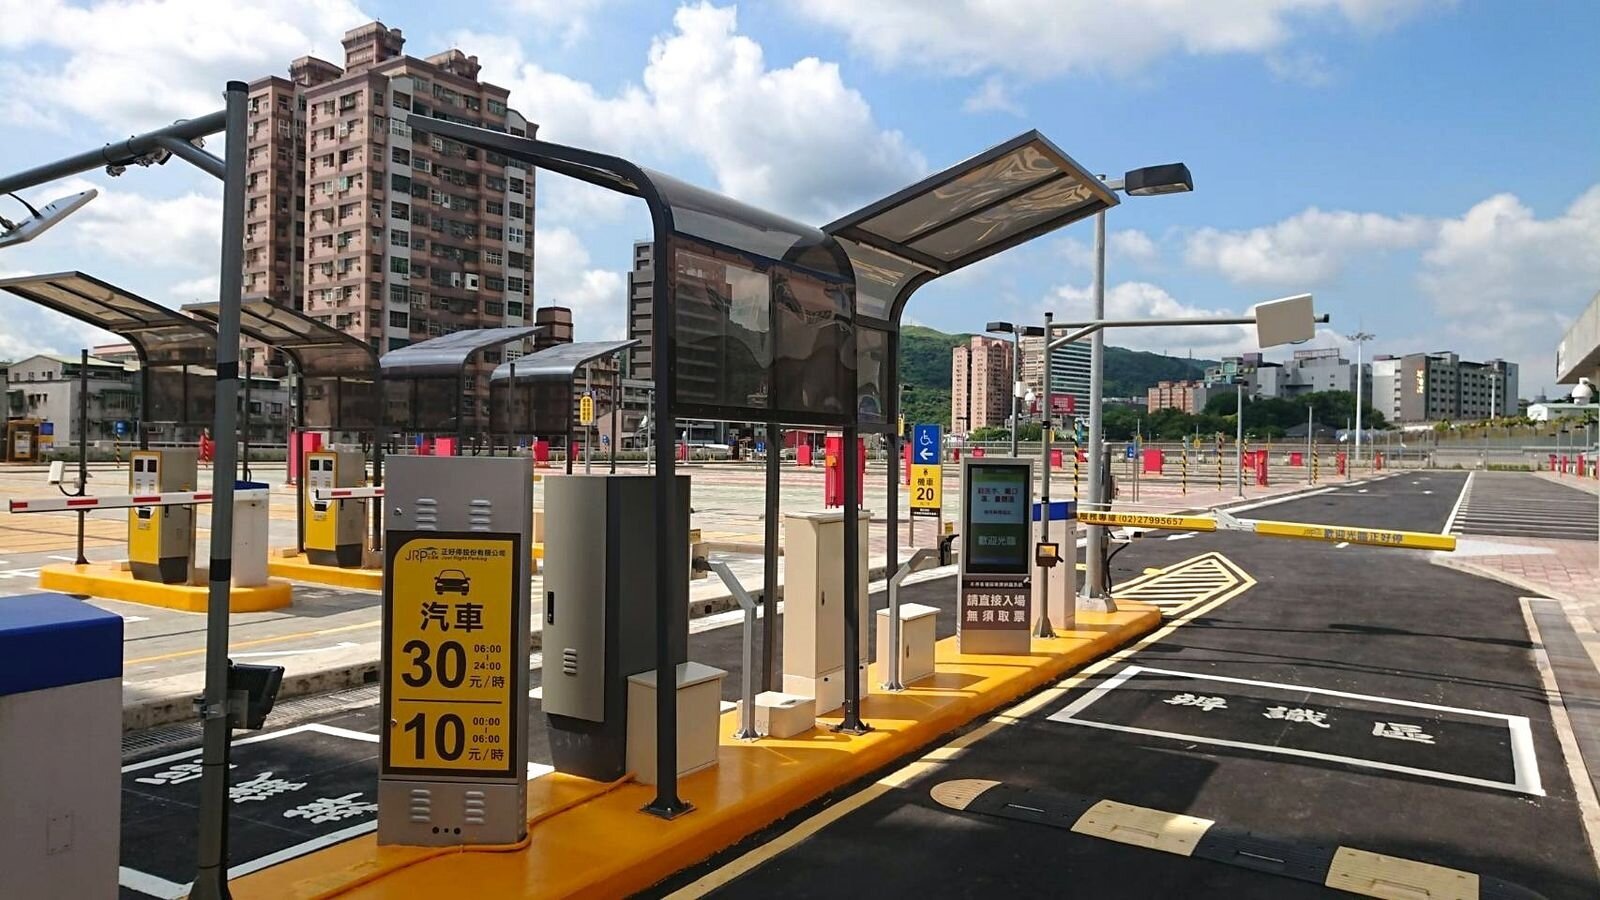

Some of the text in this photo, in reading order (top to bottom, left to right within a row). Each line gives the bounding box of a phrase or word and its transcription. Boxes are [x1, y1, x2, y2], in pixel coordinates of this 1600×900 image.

[917, 478, 934, 486] 機車
[916, 487, 934, 501] 20
[966, 594, 1026, 607] 請直接入場
[420, 602, 484, 632] 汽車
[966, 609, 1025, 622] 無須取票
[474, 644, 502, 653] 06:00
[401, 640, 467, 689] 30
[473, 662, 501, 671] 24:00
[469, 675, 505, 689] 元/時
[472, 717, 501, 726] 00:00
[404, 712, 466, 761] 10
[472, 734, 500, 743] 06:00
[468, 747, 504, 761] 元/時
